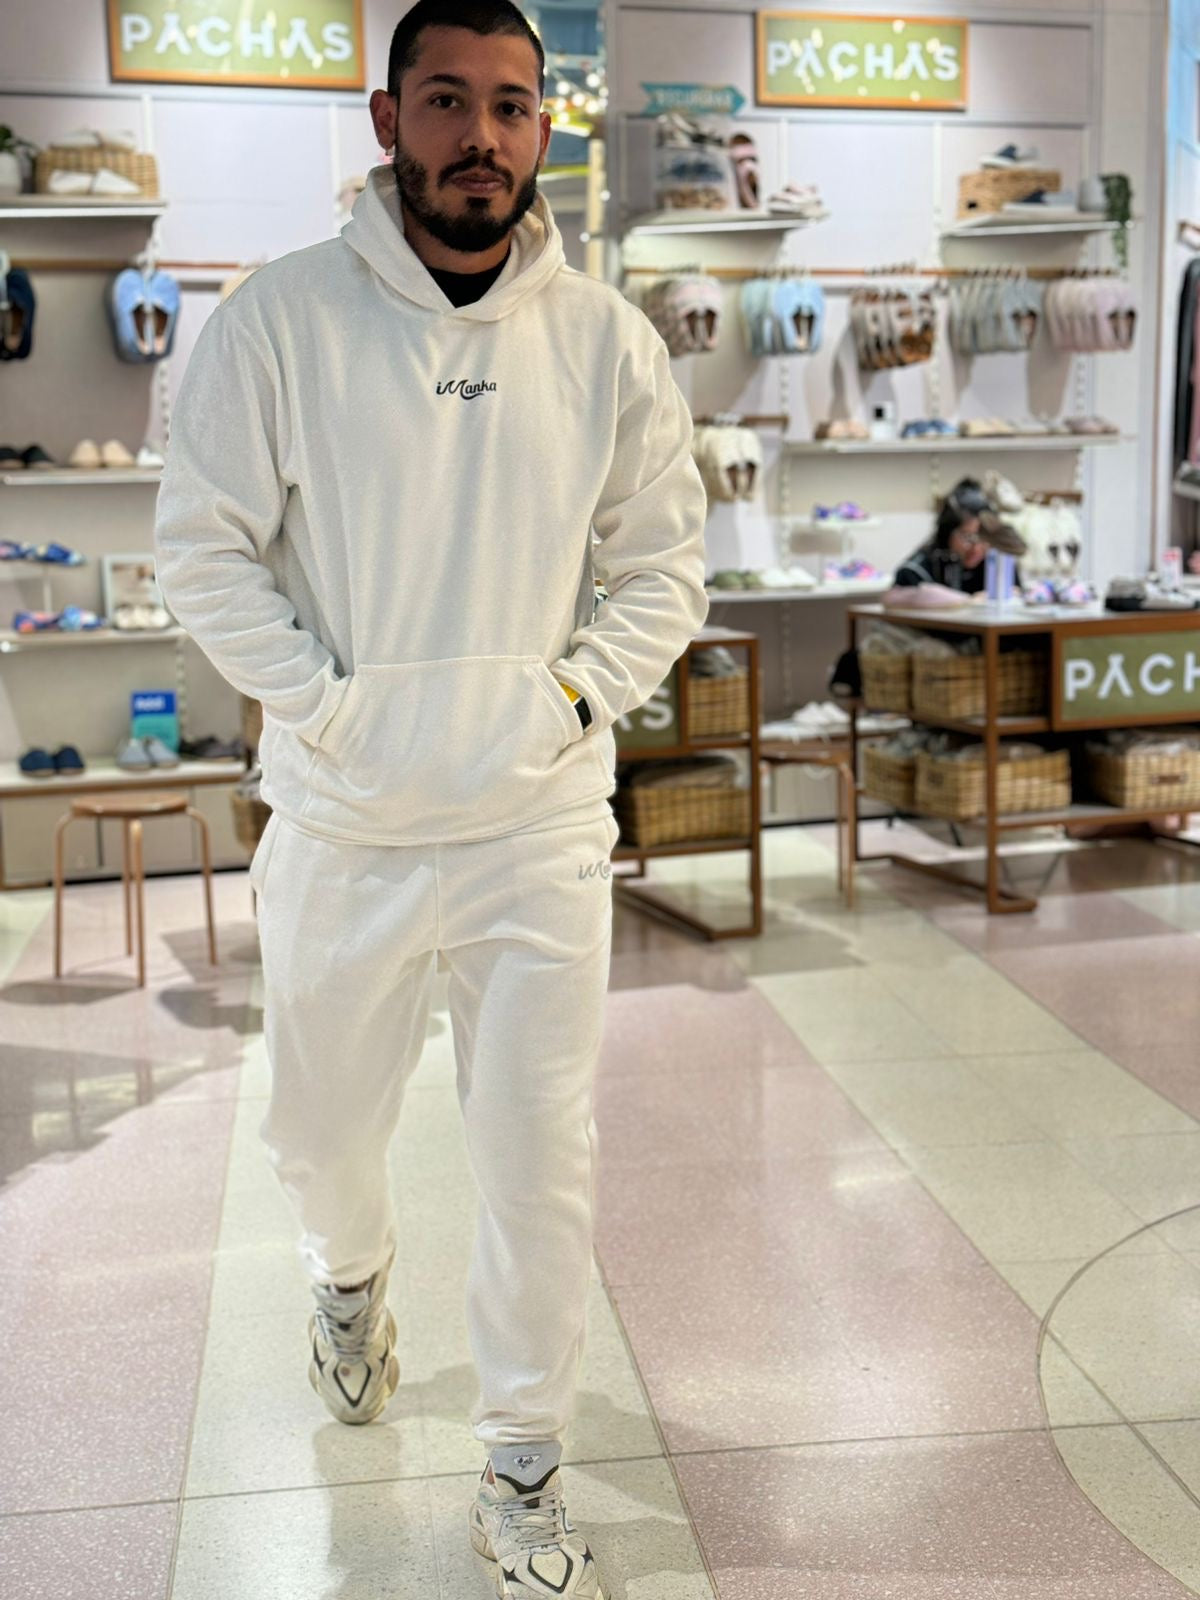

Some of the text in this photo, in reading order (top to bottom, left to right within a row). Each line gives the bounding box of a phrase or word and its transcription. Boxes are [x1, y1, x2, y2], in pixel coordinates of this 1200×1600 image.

[120, 12, 353, 62] PACHAS
[767, 38, 960, 82] PACHAS
[436, 379, 497, 401] iManka
